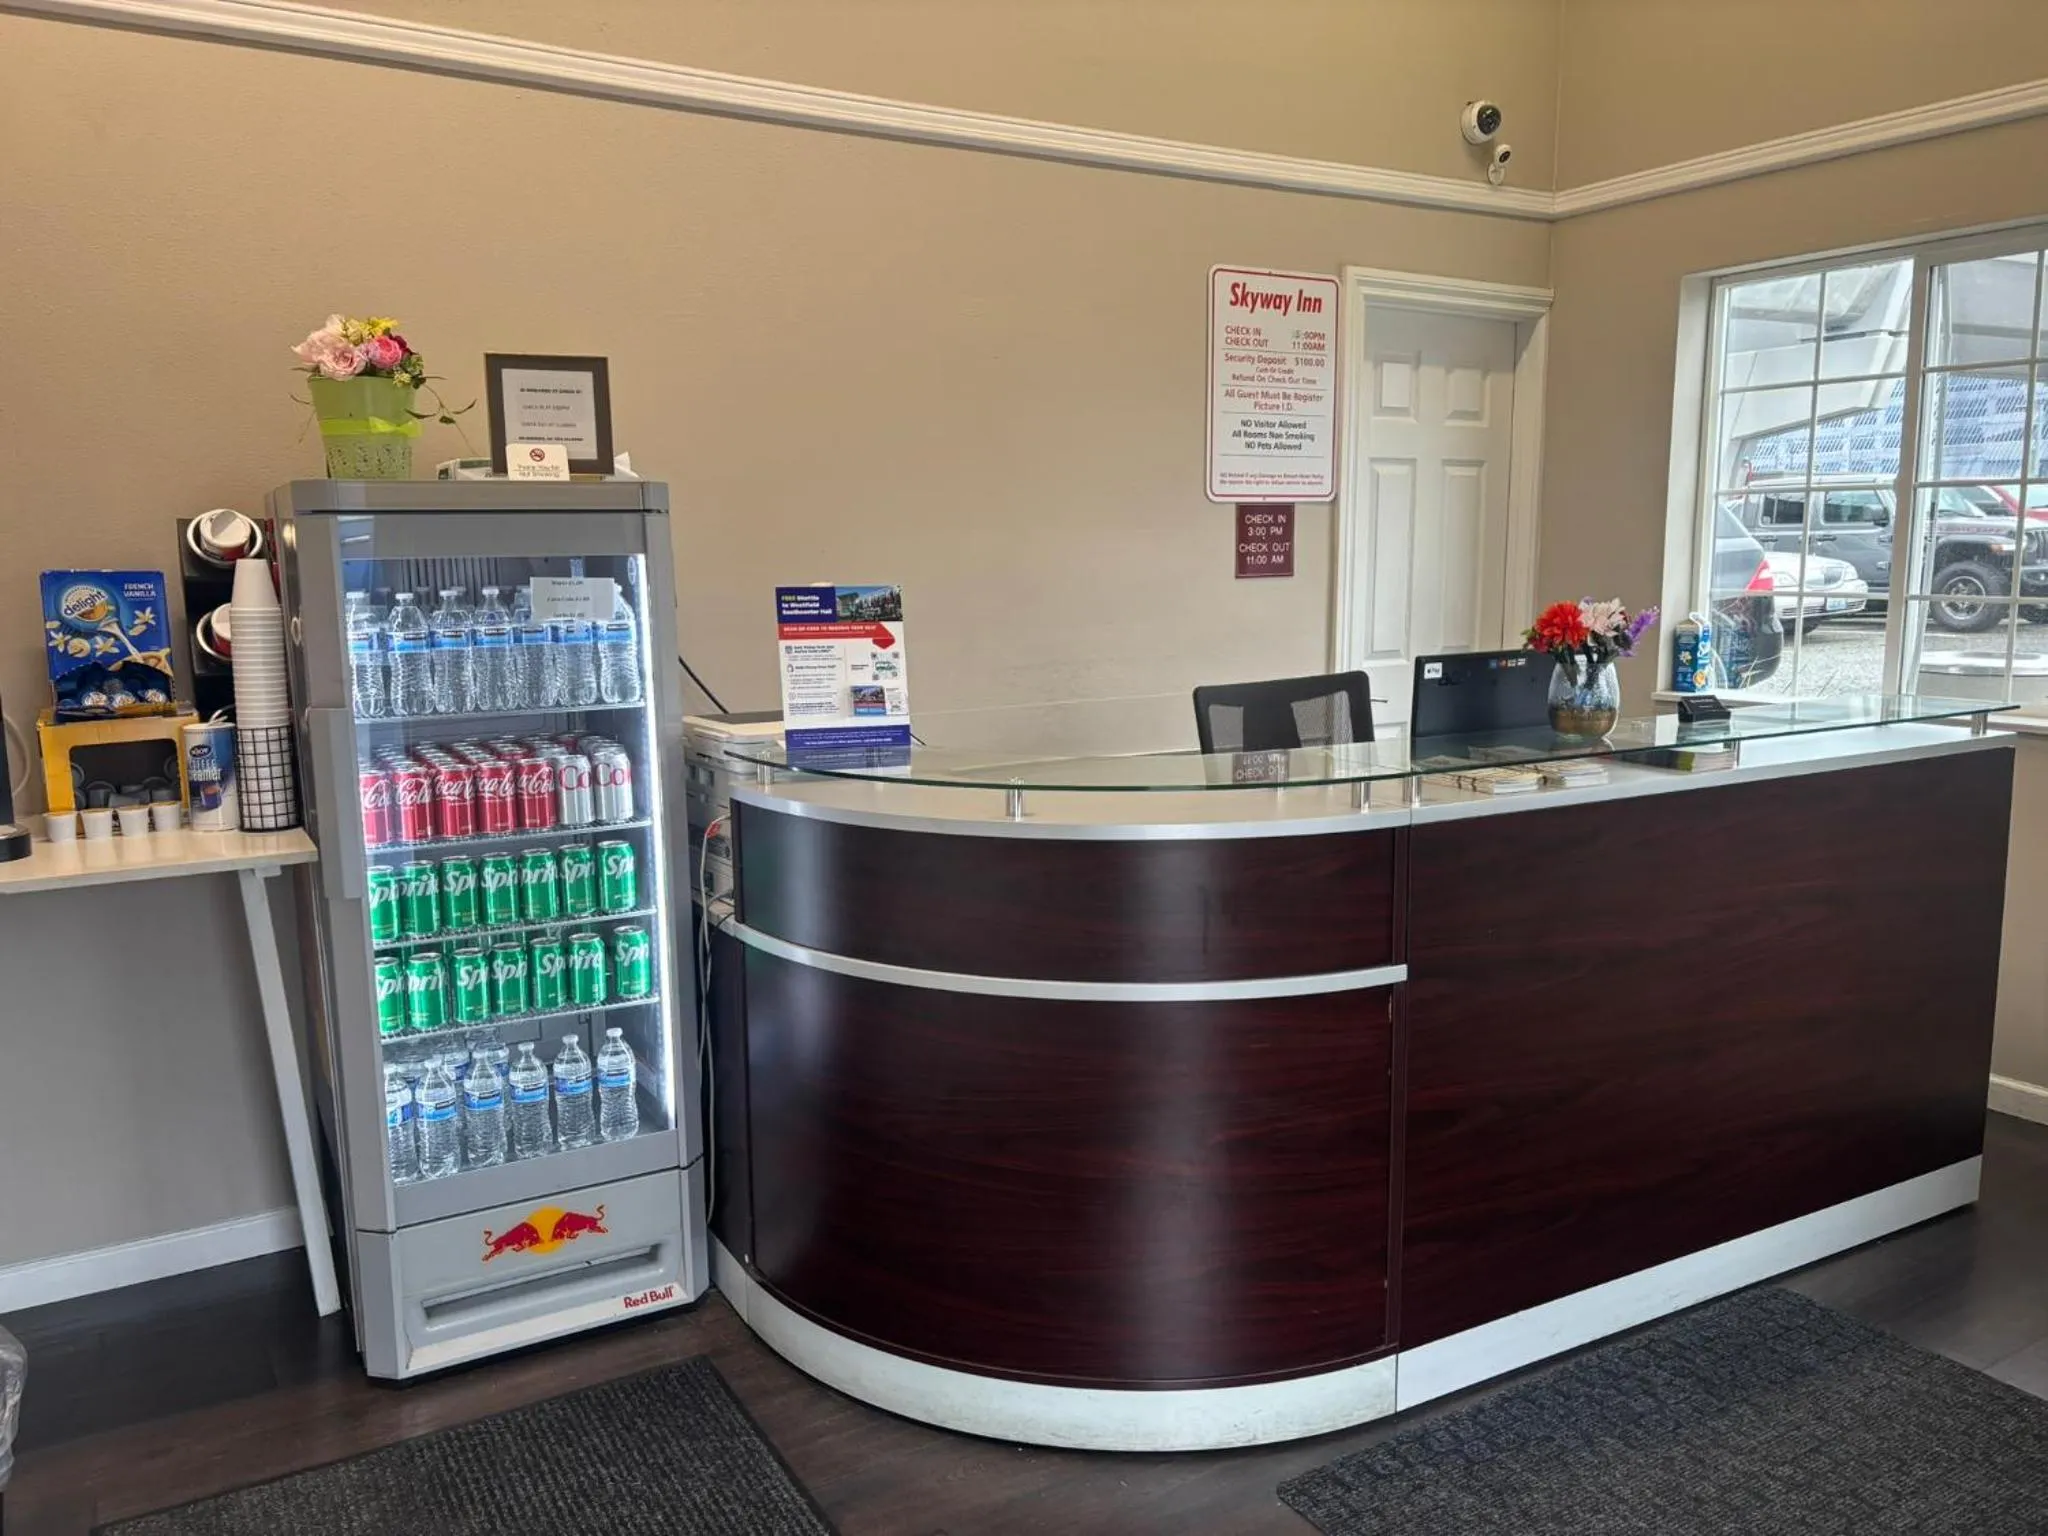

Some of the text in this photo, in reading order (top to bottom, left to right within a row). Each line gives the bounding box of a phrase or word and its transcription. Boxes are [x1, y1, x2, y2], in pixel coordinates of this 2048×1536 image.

[1230, 282, 1323, 316] Skyway Inn
[1225, 325, 1252, 335] CHECK
[1252, 327, 1262, 336] IN
[1225, 337, 1252, 346] CHECK
[1252, 338, 1269, 347] OUT
[1224, 353, 1255, 364] Security
[1257, 355, 1287, 366] Deposit
[1224, 390, 1323, 403] All Guest Must Be Register
[1254, 401, 1280, 411] Picture
[1241, 419, 1307, 430] NO Visitor Allowed
[1232, 430, 1242, 438] All
[1243, 430, 1267, 440] Rooms
[1284, 431, 1315, 442] Smoking
[1245, 441, 1302, 451] NO Pets Allowed
[1245, 515, 1287, 525] CHECK IN
[1270, 526, 1283, 536] PM
[1239, 542, 1290, 553] CHECK OUT
[1246, 555, 1285, 565] 11:00 AM
[124, 590, 156, 598] VANILLA
[63, 590, 107, 617] delight
[624, 1285, 673, 1309] Red Bull
